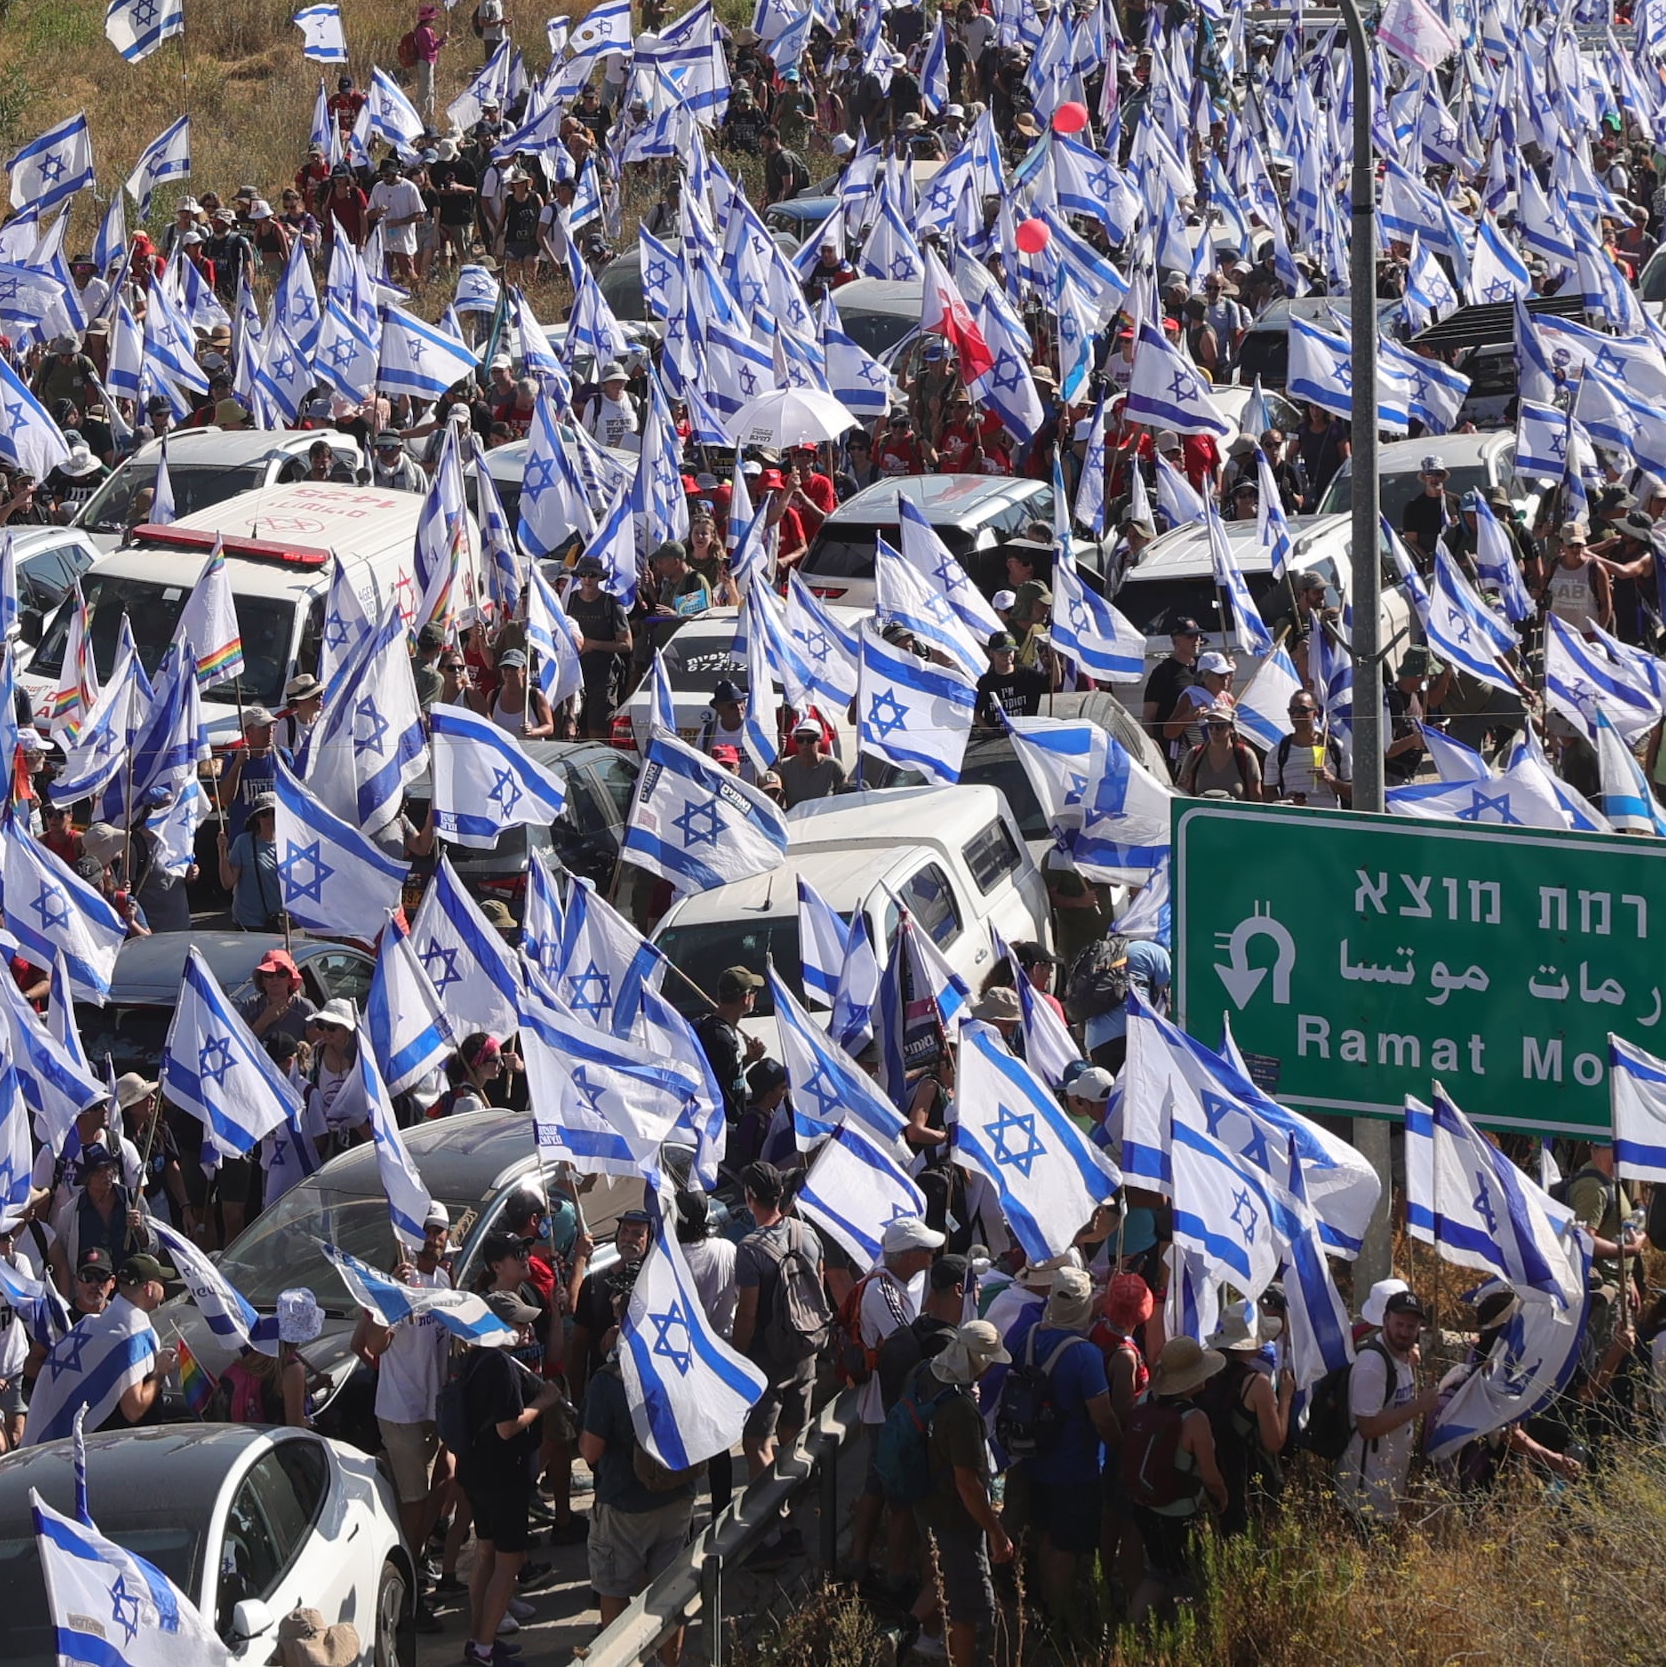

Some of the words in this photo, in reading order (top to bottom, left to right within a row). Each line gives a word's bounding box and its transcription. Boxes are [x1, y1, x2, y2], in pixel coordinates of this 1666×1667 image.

[290, 488, 397, 509] 1425
[1354, 869, 1501, 925] מוצא
[1538, 883, 1648, 938] רמת
[1339, 938, 1490, 1006] موتسا
[1528, 960, 1663, 1026] رمات
[1297, 1013, 1486, 1076] Ramat
